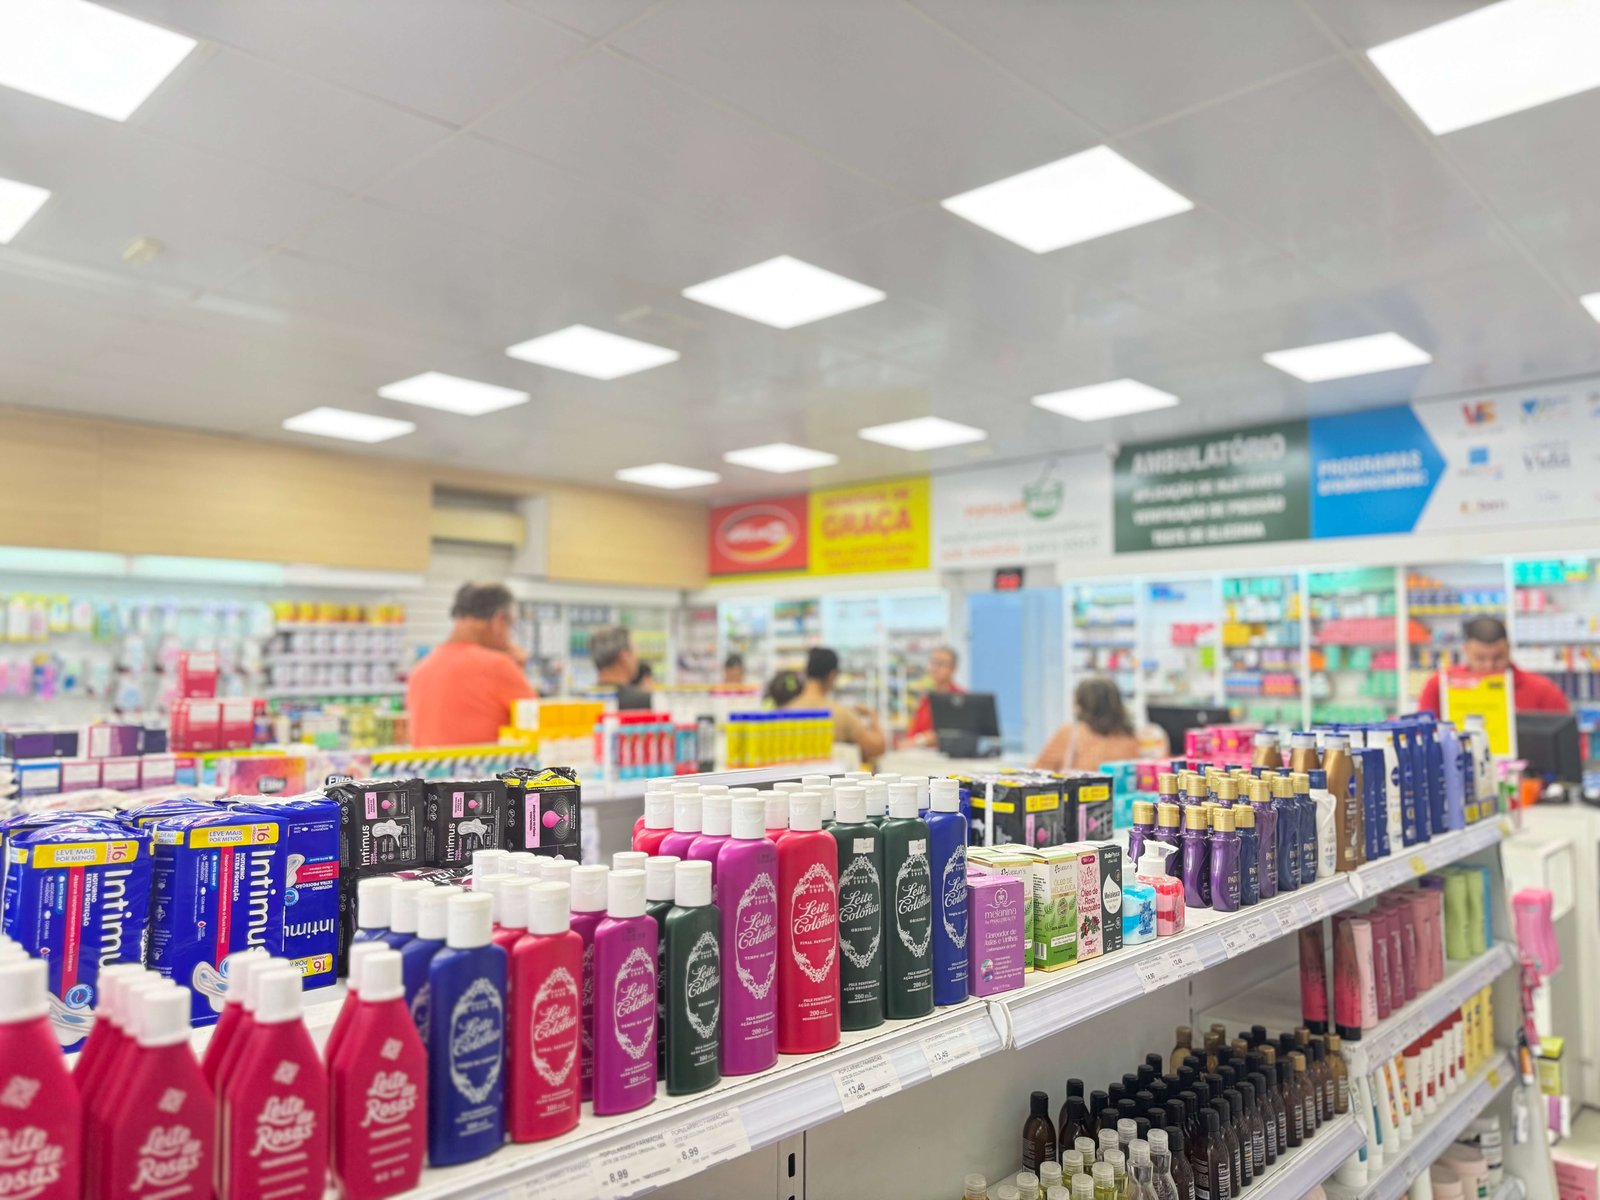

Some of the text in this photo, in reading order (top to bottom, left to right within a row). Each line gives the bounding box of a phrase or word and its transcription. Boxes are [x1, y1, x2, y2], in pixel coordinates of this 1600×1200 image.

[1131, 432, 1287, 475] AMBULATÓRIO
[1318, 450, 1422, 478] PROGRAMAS
[822, 507, 912, 540] GRAÇA
[209, 830, 225, 838] LEVE
[257, 826, 270, 841] 16
[446, 823, 456, 862] Intimus
[55, 848, 96, 857] LEVE MAIS
[112, 844, 128, 861] 16
[360, 825, 370, 866] Intimus
[69, 854, 96, 862] MENOS
[233, 871, 241, 902] PROTEÇÃO
[902, 883, 927, 900] Leite
[1081, 889, 1091, 897] Óleo
[843, 890, 873, 907] Leite
[899, 896, 931, 914] Colônia
[1078, 903, 1100, 913] Mosqueta
[1084, 897, 1095, 905] Rosa
[82, 894, 91, 926] PROTEÇÃO
[98, 869, 133, 968] Intimu
[798, 900, 829, 919] Leite
[839, 903, 880, 923] Colônia
[984, 907, 1017, 920] melanina
[283, 918, 334, 940] Intimu
[743, 911, 772, 933] Leite
[794, 914, 835, 935] Colônia
[738, 926, 776, 950] Colônia
[985, 930, 1009, 939] Clareador
[313, 960, 327, 972] 16
[692, 965, 716, 983] Leite
[621, 982, 649, 1001] Leite
[688, 975, 720, 998] Colônia
[539, 1004, 570, 1024] Leite
[617, 993, 654, 1017] Colônia
[809, 1009, 819, 1017] 200
[459, 1016, 494, 1037] Leite
[534, 1016, 577, 1041] Colônia
[751, 1028, 761, 1036] 200
[934, 1050, 949, 1062] 13,49
[368, 1071, 409, 1098] Leite
[400, 1084, 416, 1098] de
[848, 1082, 866, 1095] 13,49
[258, 1096, 304, 1125] Leite
[296, 1110, 315, 1126] de
[361, 1095, 418, 1128] Rosas
[139, 1125, 191, 1157] Leite
[181, 1139, 201, 1155] de
[250, 1122, 316, 1156] Rosas
[35, 1145, 63, 1165] de
[681, 1146, 699, 1160] 8,99
[130, 1153, 203, 1192] Rosas
[609, 1169, 629, 1183] 8,99
